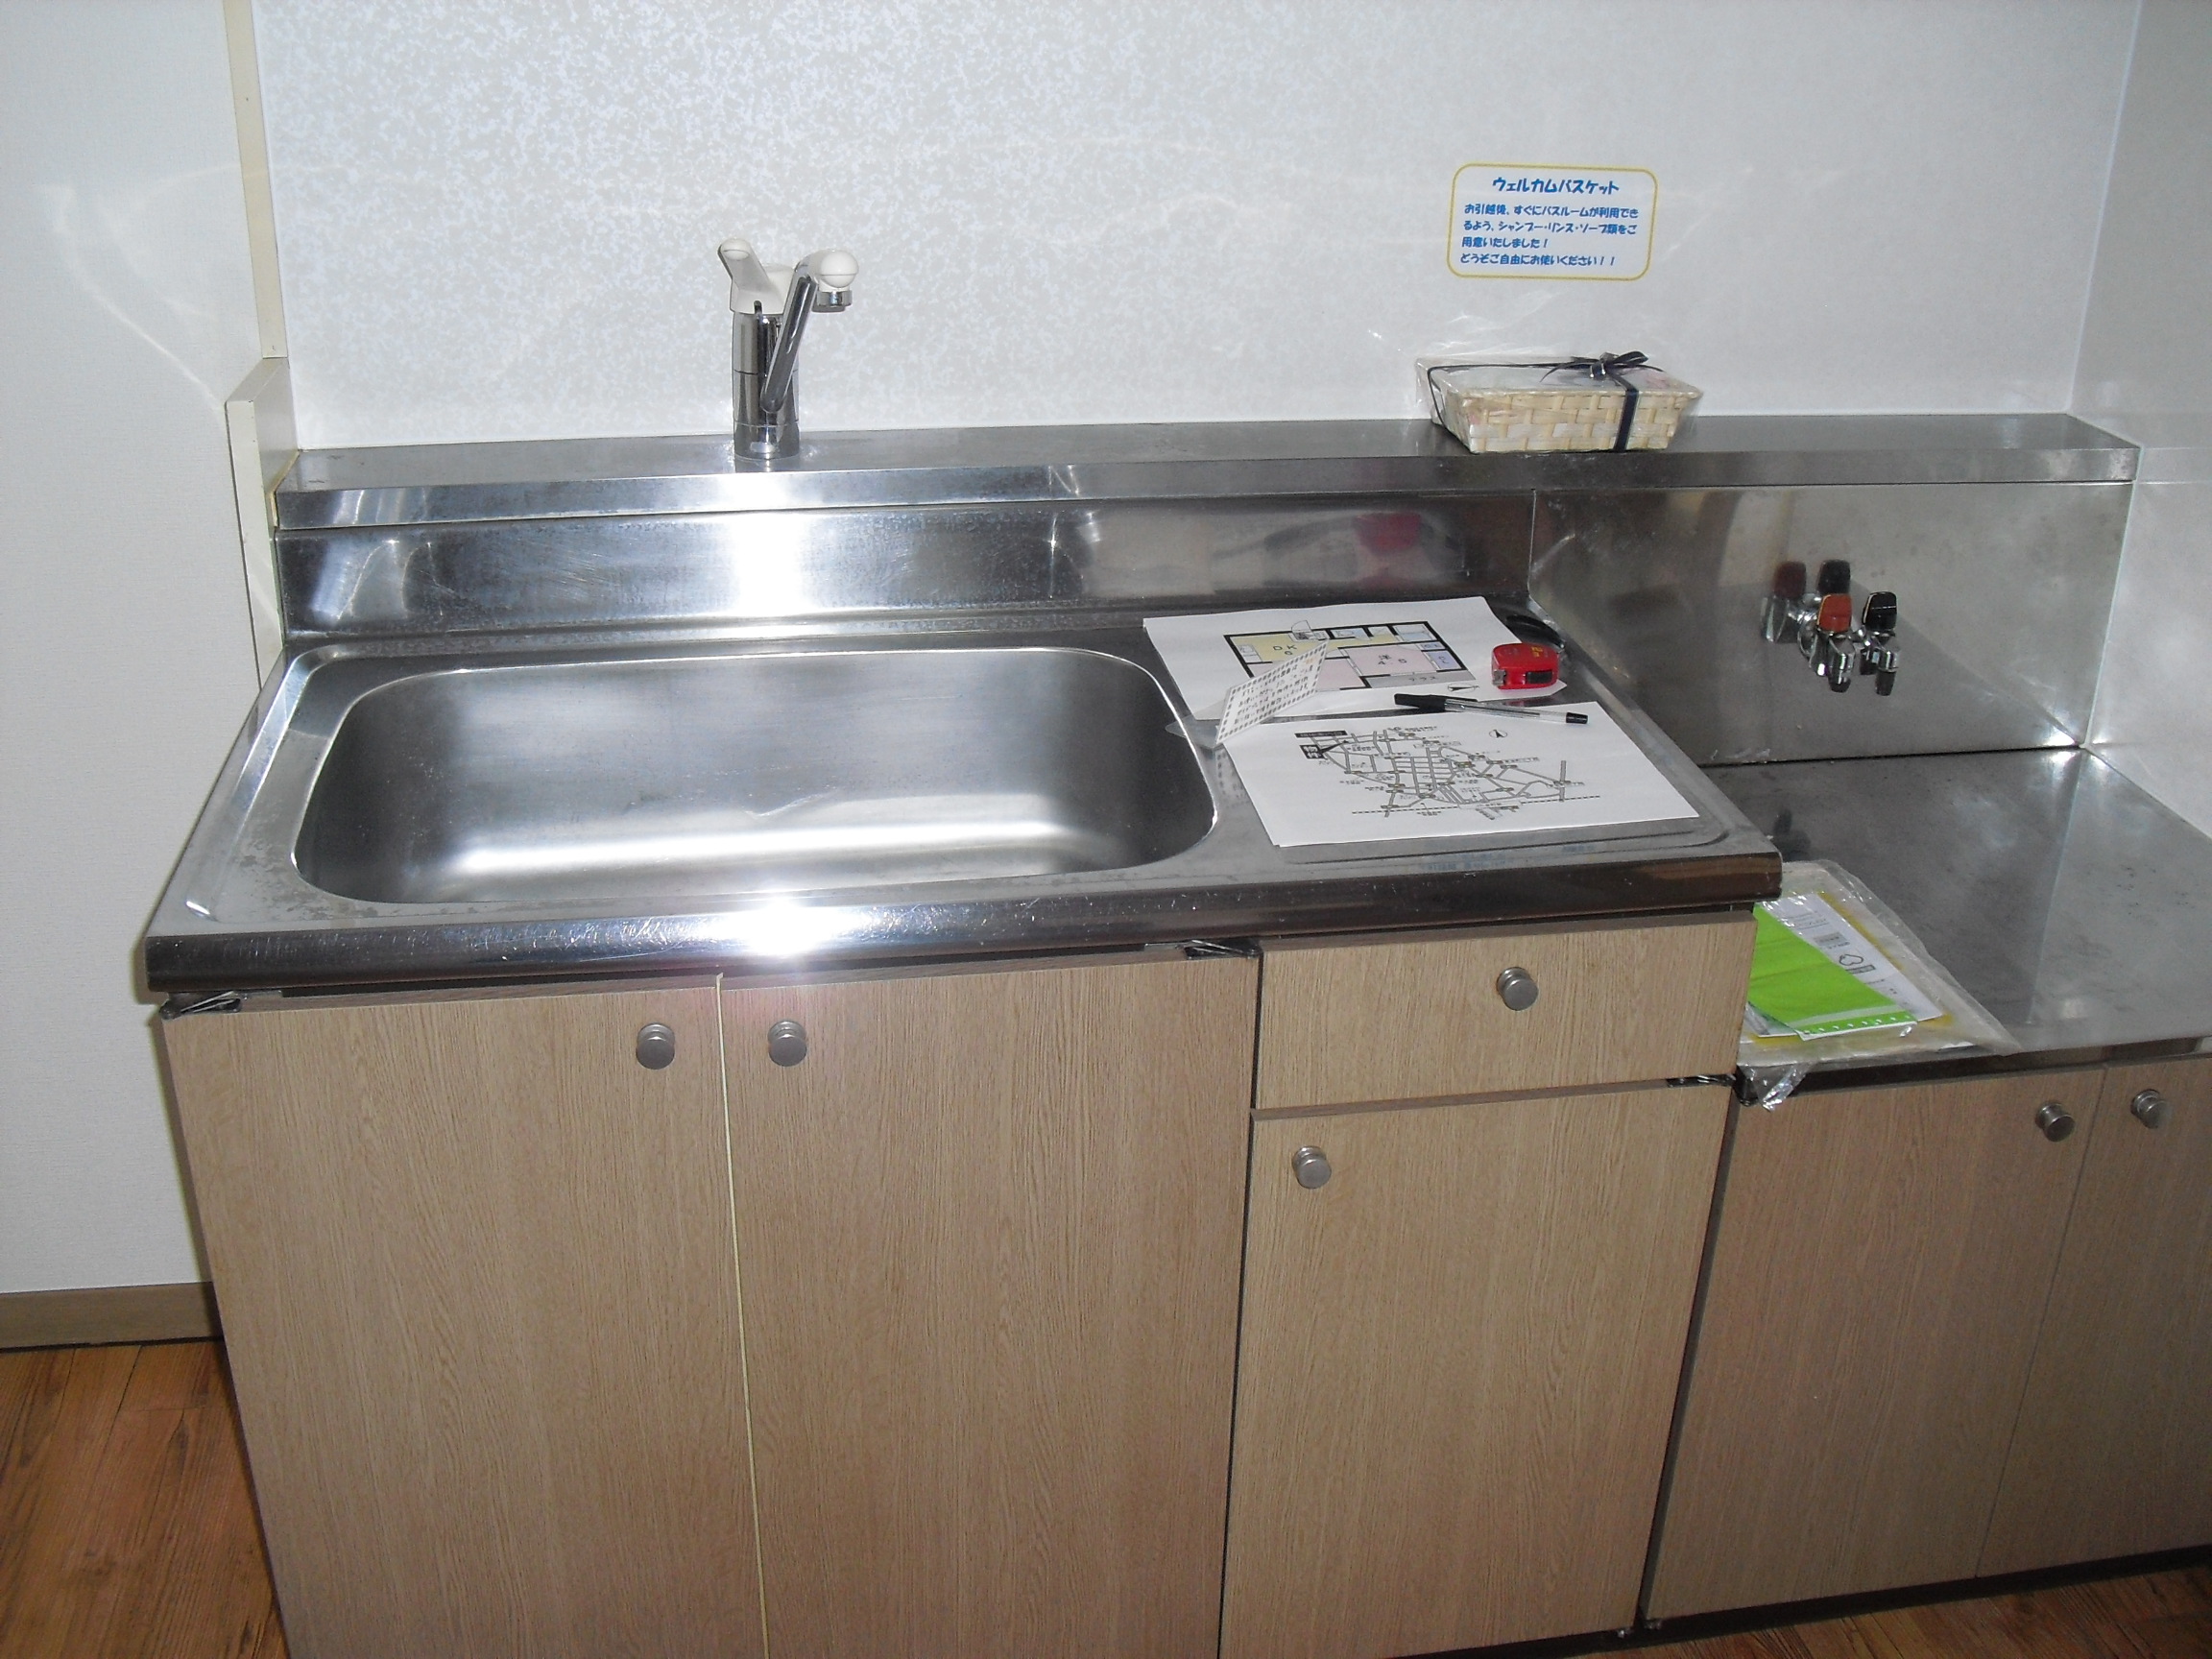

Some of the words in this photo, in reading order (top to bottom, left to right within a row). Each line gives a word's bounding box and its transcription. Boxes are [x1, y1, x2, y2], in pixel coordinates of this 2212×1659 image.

[1492, 177, 1620, 195] ウェルカムバスケット
